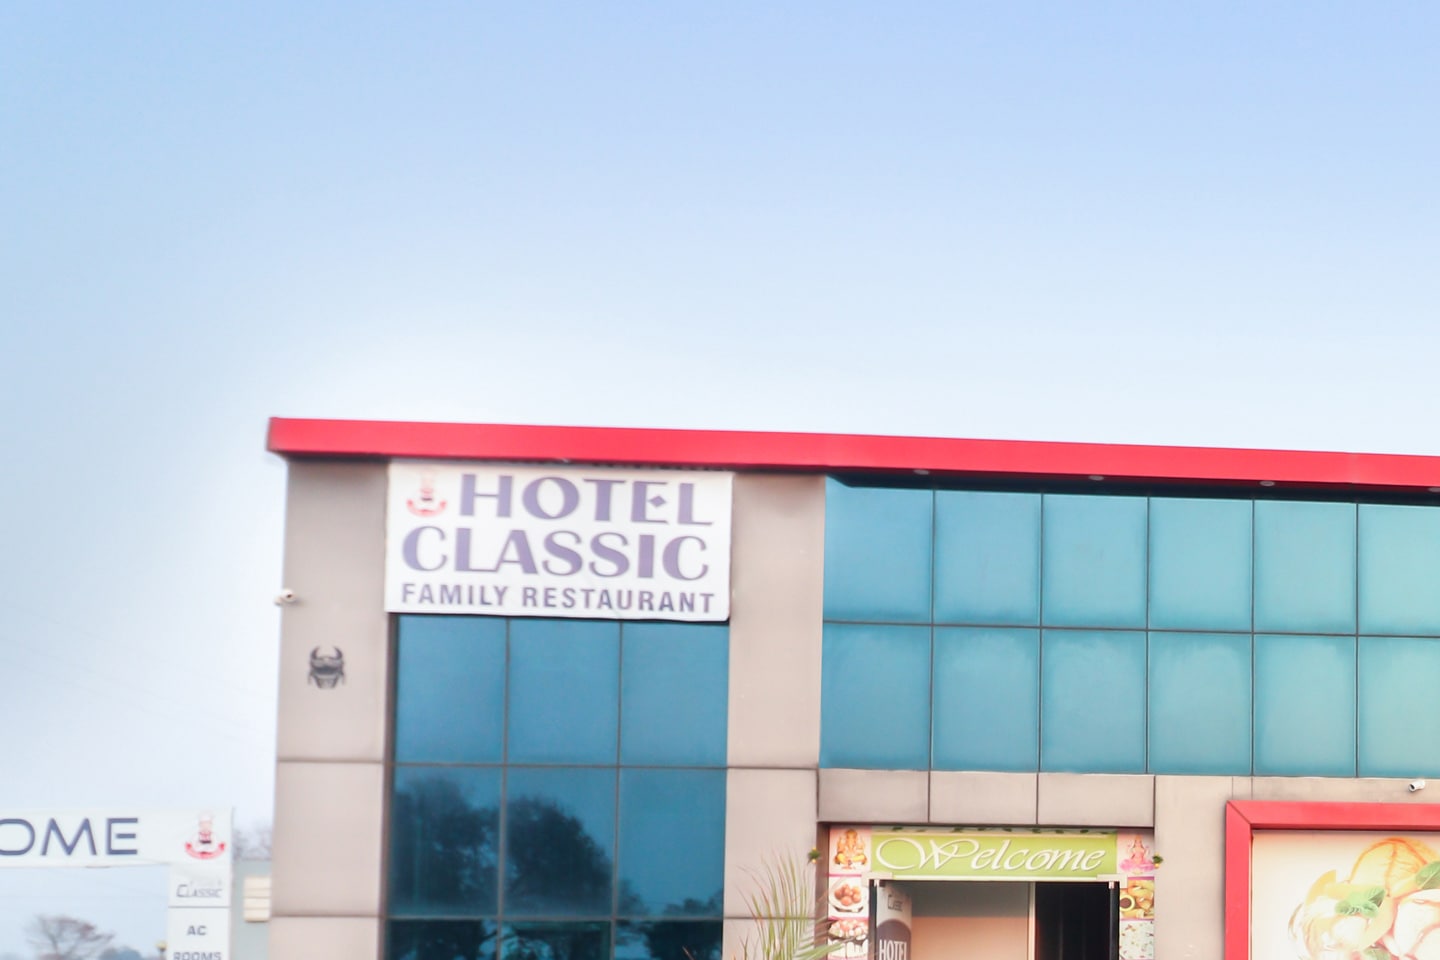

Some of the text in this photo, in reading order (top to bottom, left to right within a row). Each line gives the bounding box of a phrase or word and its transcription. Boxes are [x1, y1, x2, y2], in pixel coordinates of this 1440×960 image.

[459, 473, 713, 526] HOTEL
[402, 525, 709, 581] CLASSIC
[401, 583, 715, 613] FAMILY RESTAURANT
[876, 837, 1106, 871] Welcome
[186, 925, 207, 936] AC
